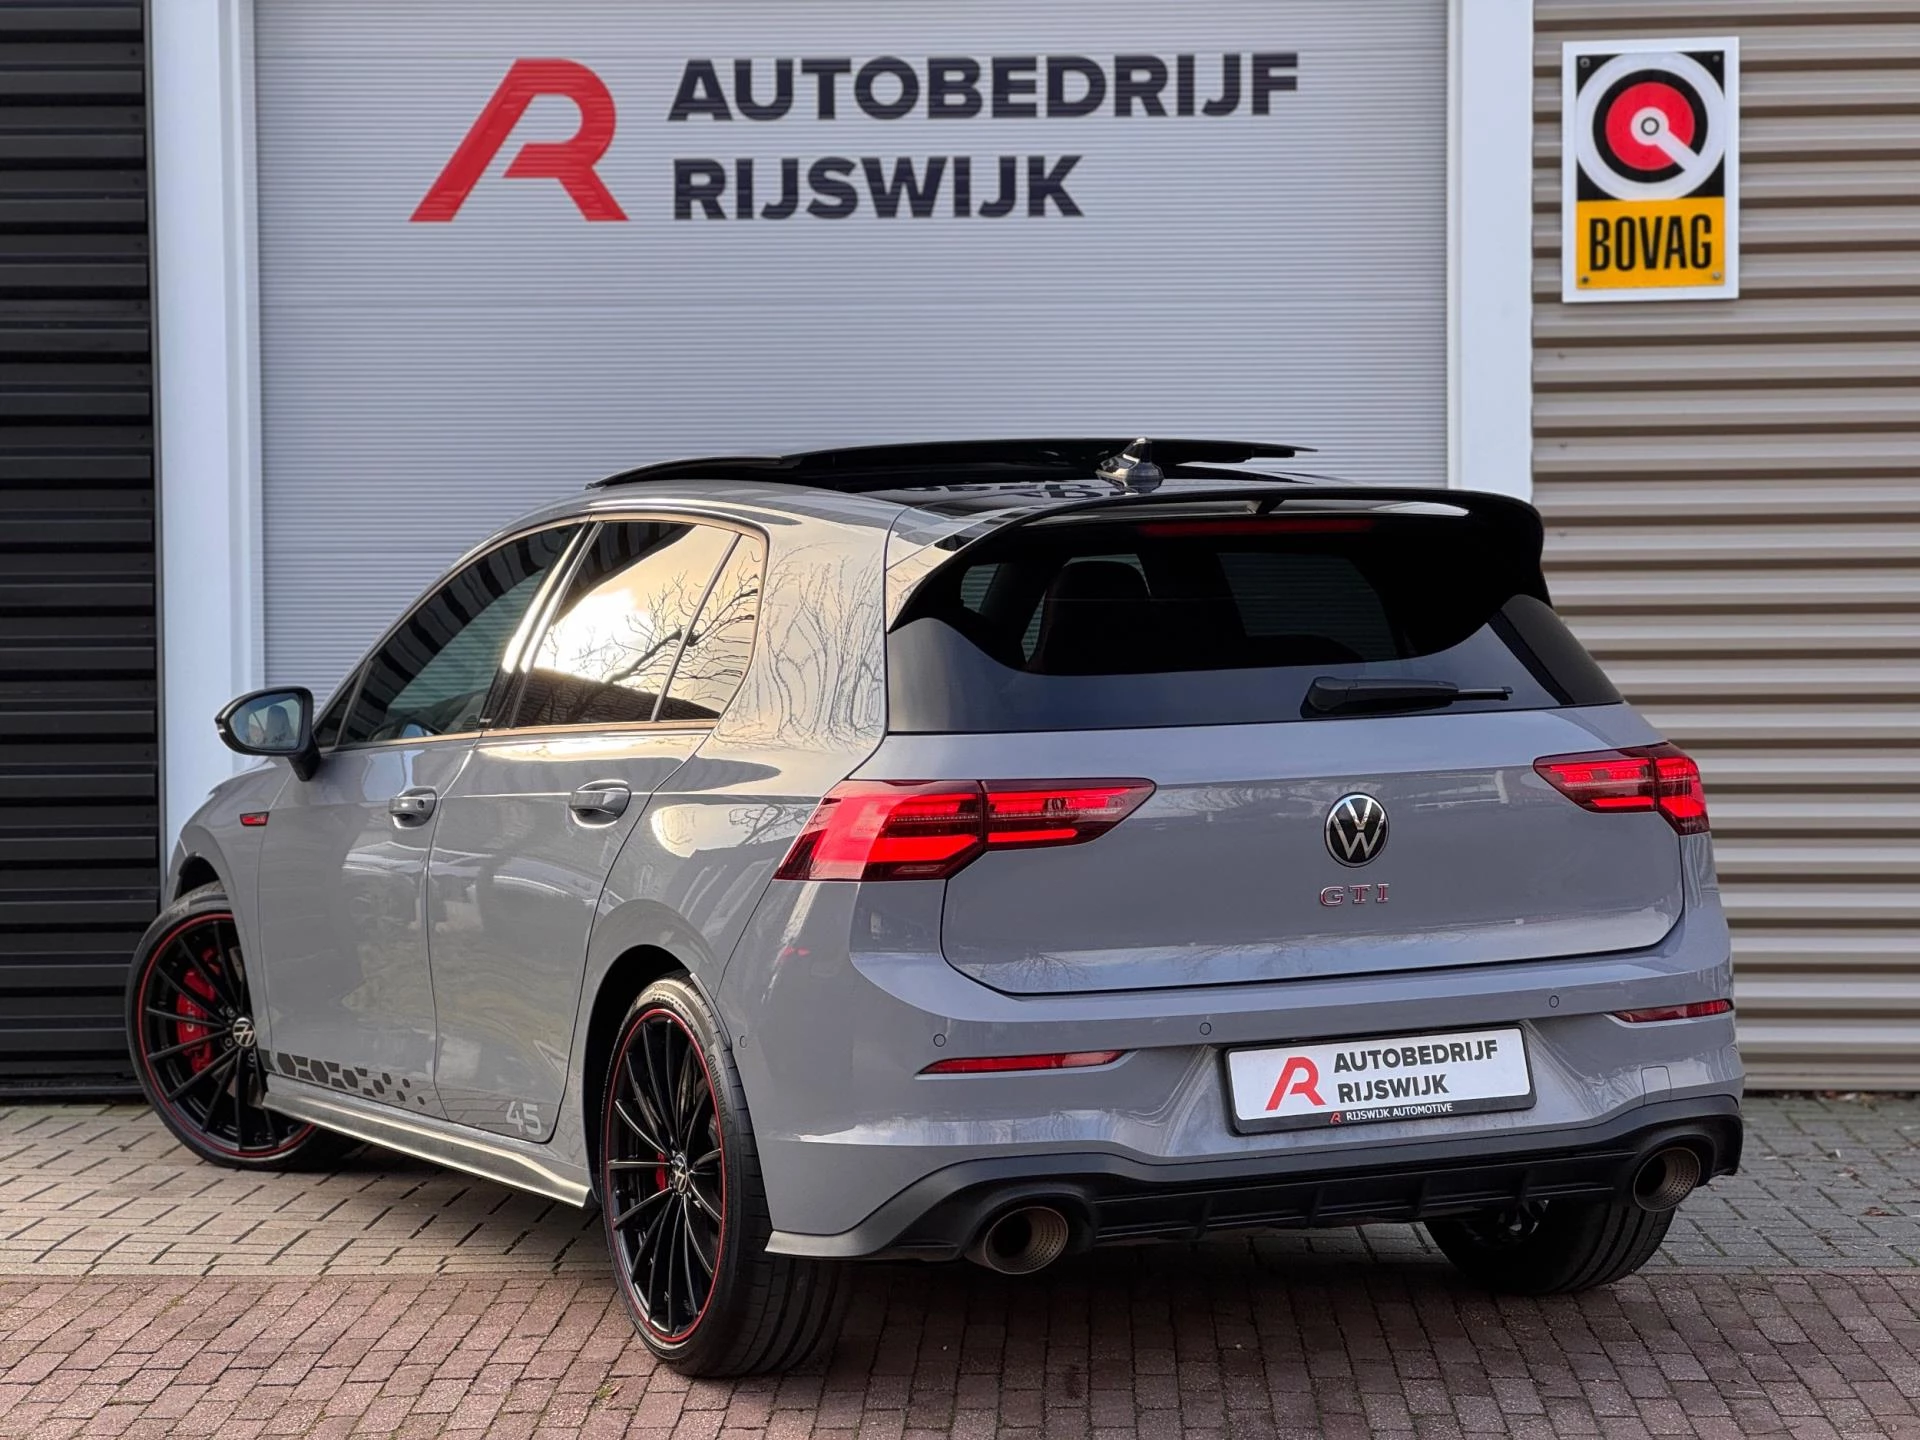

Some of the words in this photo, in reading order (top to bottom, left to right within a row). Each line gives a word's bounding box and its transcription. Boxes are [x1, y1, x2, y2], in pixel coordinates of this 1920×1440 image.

[667, 52, 1298, 122] AUTOBEDRIJF
[673, 154, 1086, 221] RIJSWIJK
[1589, 214, 1712, 271] BOVAG
[1320, 884, 1390, 907] GTI
[1334, 1040, 1498, 1073] AUTOBEDRIJF
[707, 1054, 730, 1118] Continental
[1337, 1074, 1450, 1103] RIJSWIJK
[506, 1101, 541, 1135] 45
[1345, 1108, 1391, 1121] RIJSWIJK
[1392, 1103, 1453, 1117] AUTOMOTIVE
